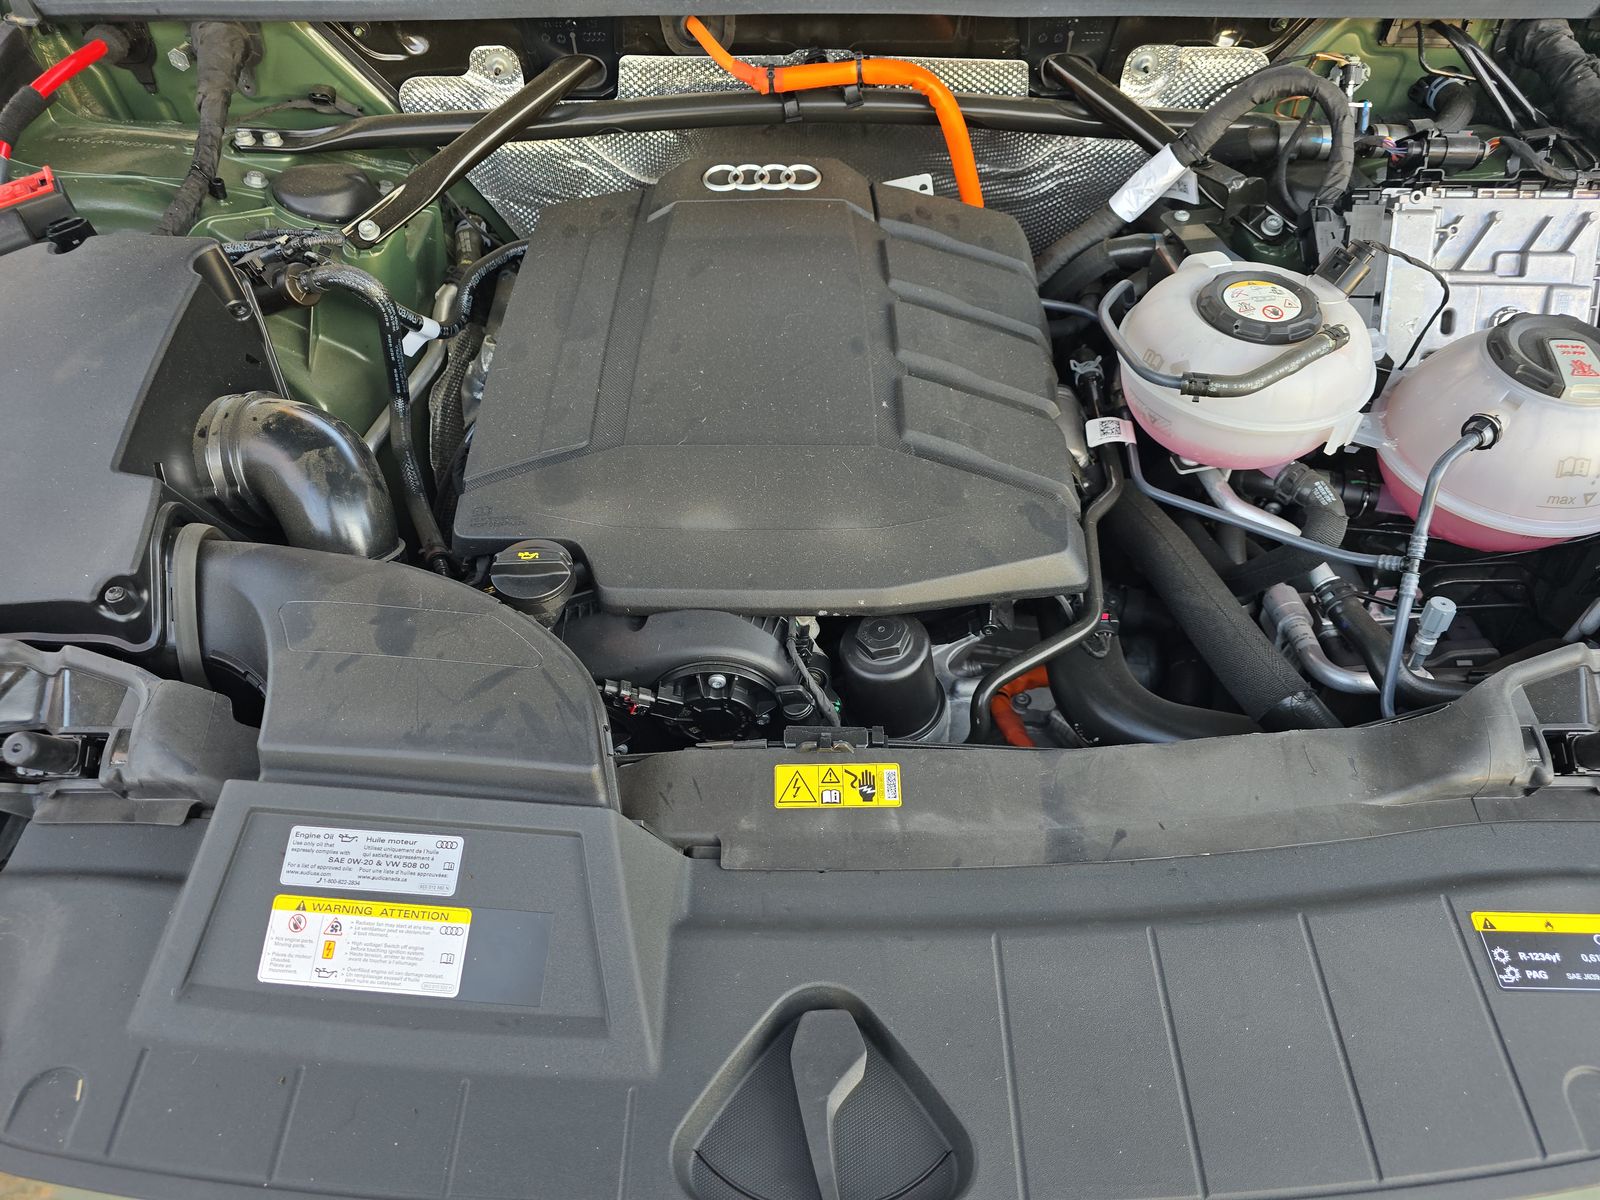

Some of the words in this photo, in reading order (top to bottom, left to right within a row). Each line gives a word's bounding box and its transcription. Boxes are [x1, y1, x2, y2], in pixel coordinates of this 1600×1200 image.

[1546, 495, 1577, 505] max
[295, 831, 321, 840] Engine
[323, 832, 335, 841] Oil
[366, 836, 386, 844] Huile
[328, 856, 345, 864] SAE
[347, 858, 374, 866] 0W-20
[385, 860, 400, 868] VW
[312, 902, 373, 915] WARNING
[379, 908, 450, 921] ATTENTION
[1517, 951, 1562, 963] R-1234yf
[1524, 969, 1549, 980] PAG
[1565, 972, 1583, 980] SAE
